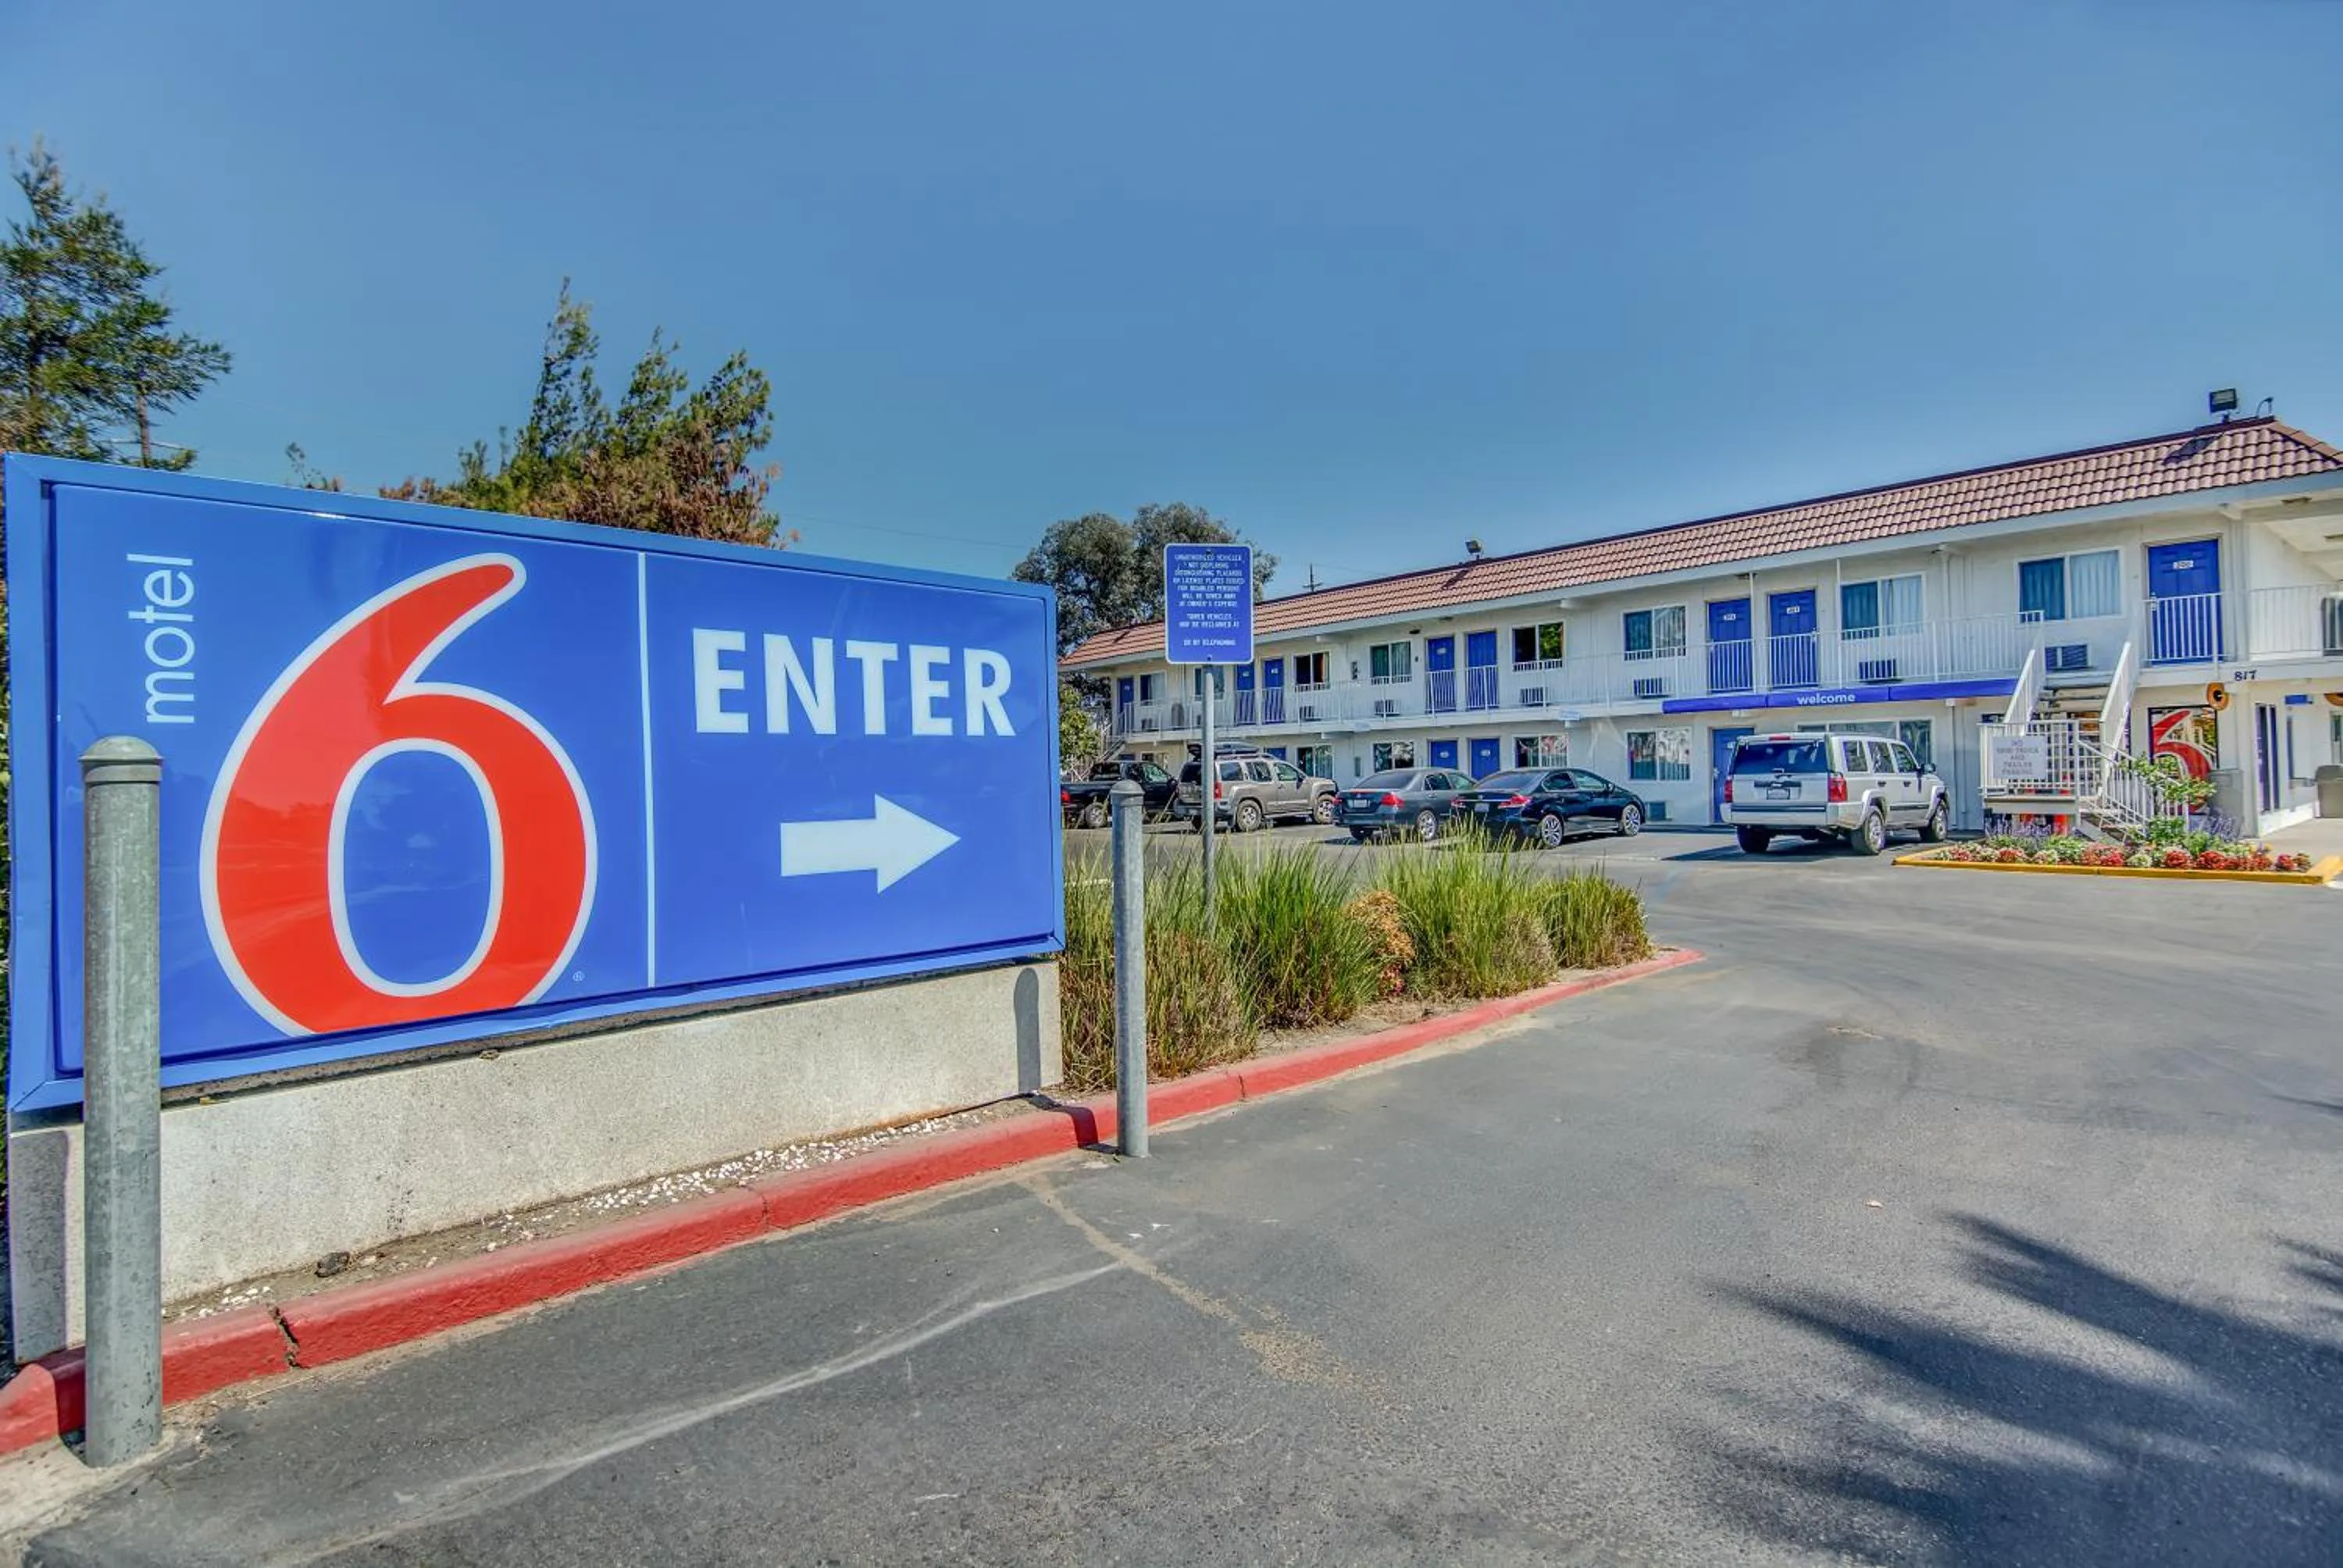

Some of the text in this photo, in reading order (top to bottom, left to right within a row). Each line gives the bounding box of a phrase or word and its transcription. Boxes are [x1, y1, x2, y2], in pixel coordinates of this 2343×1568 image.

[127, 553, 195, 725] motel
[692, 627, 1016, 736] ENTER
[2234, 669, 2258, 682] 817
[1797, 692, 1856, 705] welcome
[198, 551, 597, 1037] 6
